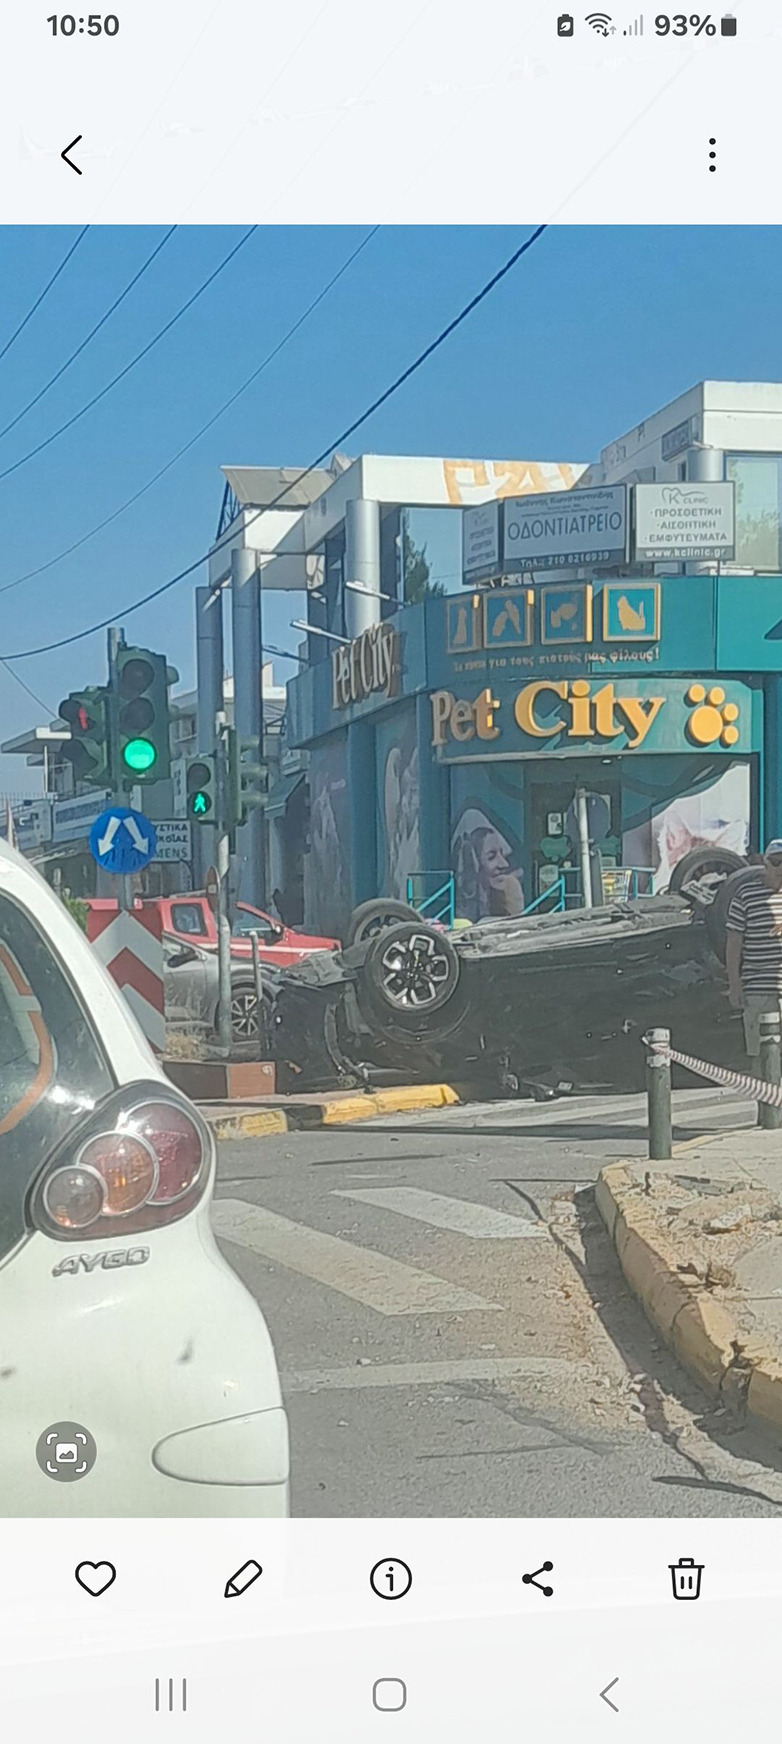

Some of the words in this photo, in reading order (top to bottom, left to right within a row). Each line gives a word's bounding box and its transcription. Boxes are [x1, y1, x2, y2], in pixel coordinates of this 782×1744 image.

[683, 496, 709, 504] CLINIC
[508, 511, 622, 541] ΟΔΟΝΤΙΑΤΡΕΙΟ
[649, 532, 727, 542] ΕΜΦΥΤΕΥΜΑΤΑ
[645, 548, 726, 558] www.kclinic.gr
[548, 556, 565, 566] 210
[331, 639, 358, 709] Pet
[361, 623, 393, 698] City
[488, 657, 506, 669] για
[510, 655, 535, 668] τους
[584, 651, 607, 664] μας
[430, 687, 500, 747] Pet
[514, 679, 667, 749] City
[153, 823, 188, 832] ΥΣΤΙΚΑ
[52, 1245, 150, 1277] AYGO
